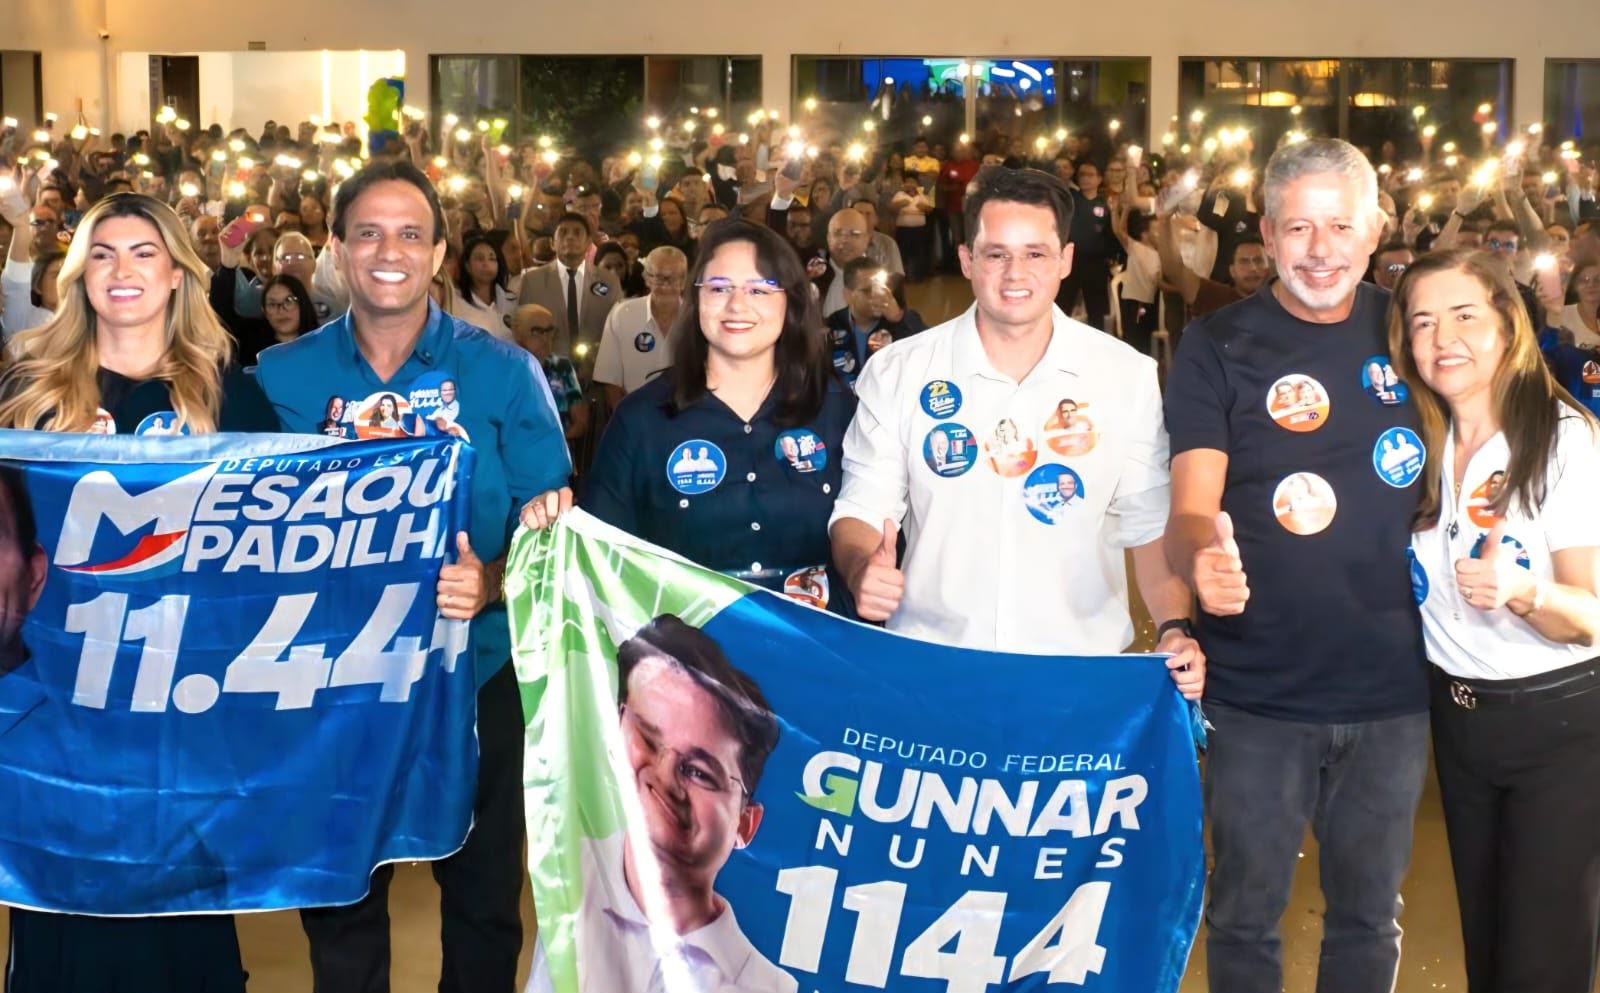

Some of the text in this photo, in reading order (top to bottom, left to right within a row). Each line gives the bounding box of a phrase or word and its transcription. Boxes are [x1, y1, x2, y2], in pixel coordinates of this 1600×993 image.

[223, 457, 361, 472] DEPUTADO
[53, 457, 457, 573] MESAQU
[842, 727, 1127, 773] DEPUTADO FEDERAL
[794, 750, 1149, 838] GUNNAR
[814, 818, 1127, 880] NUNES
[775, 865, 1112, 993] 1144
